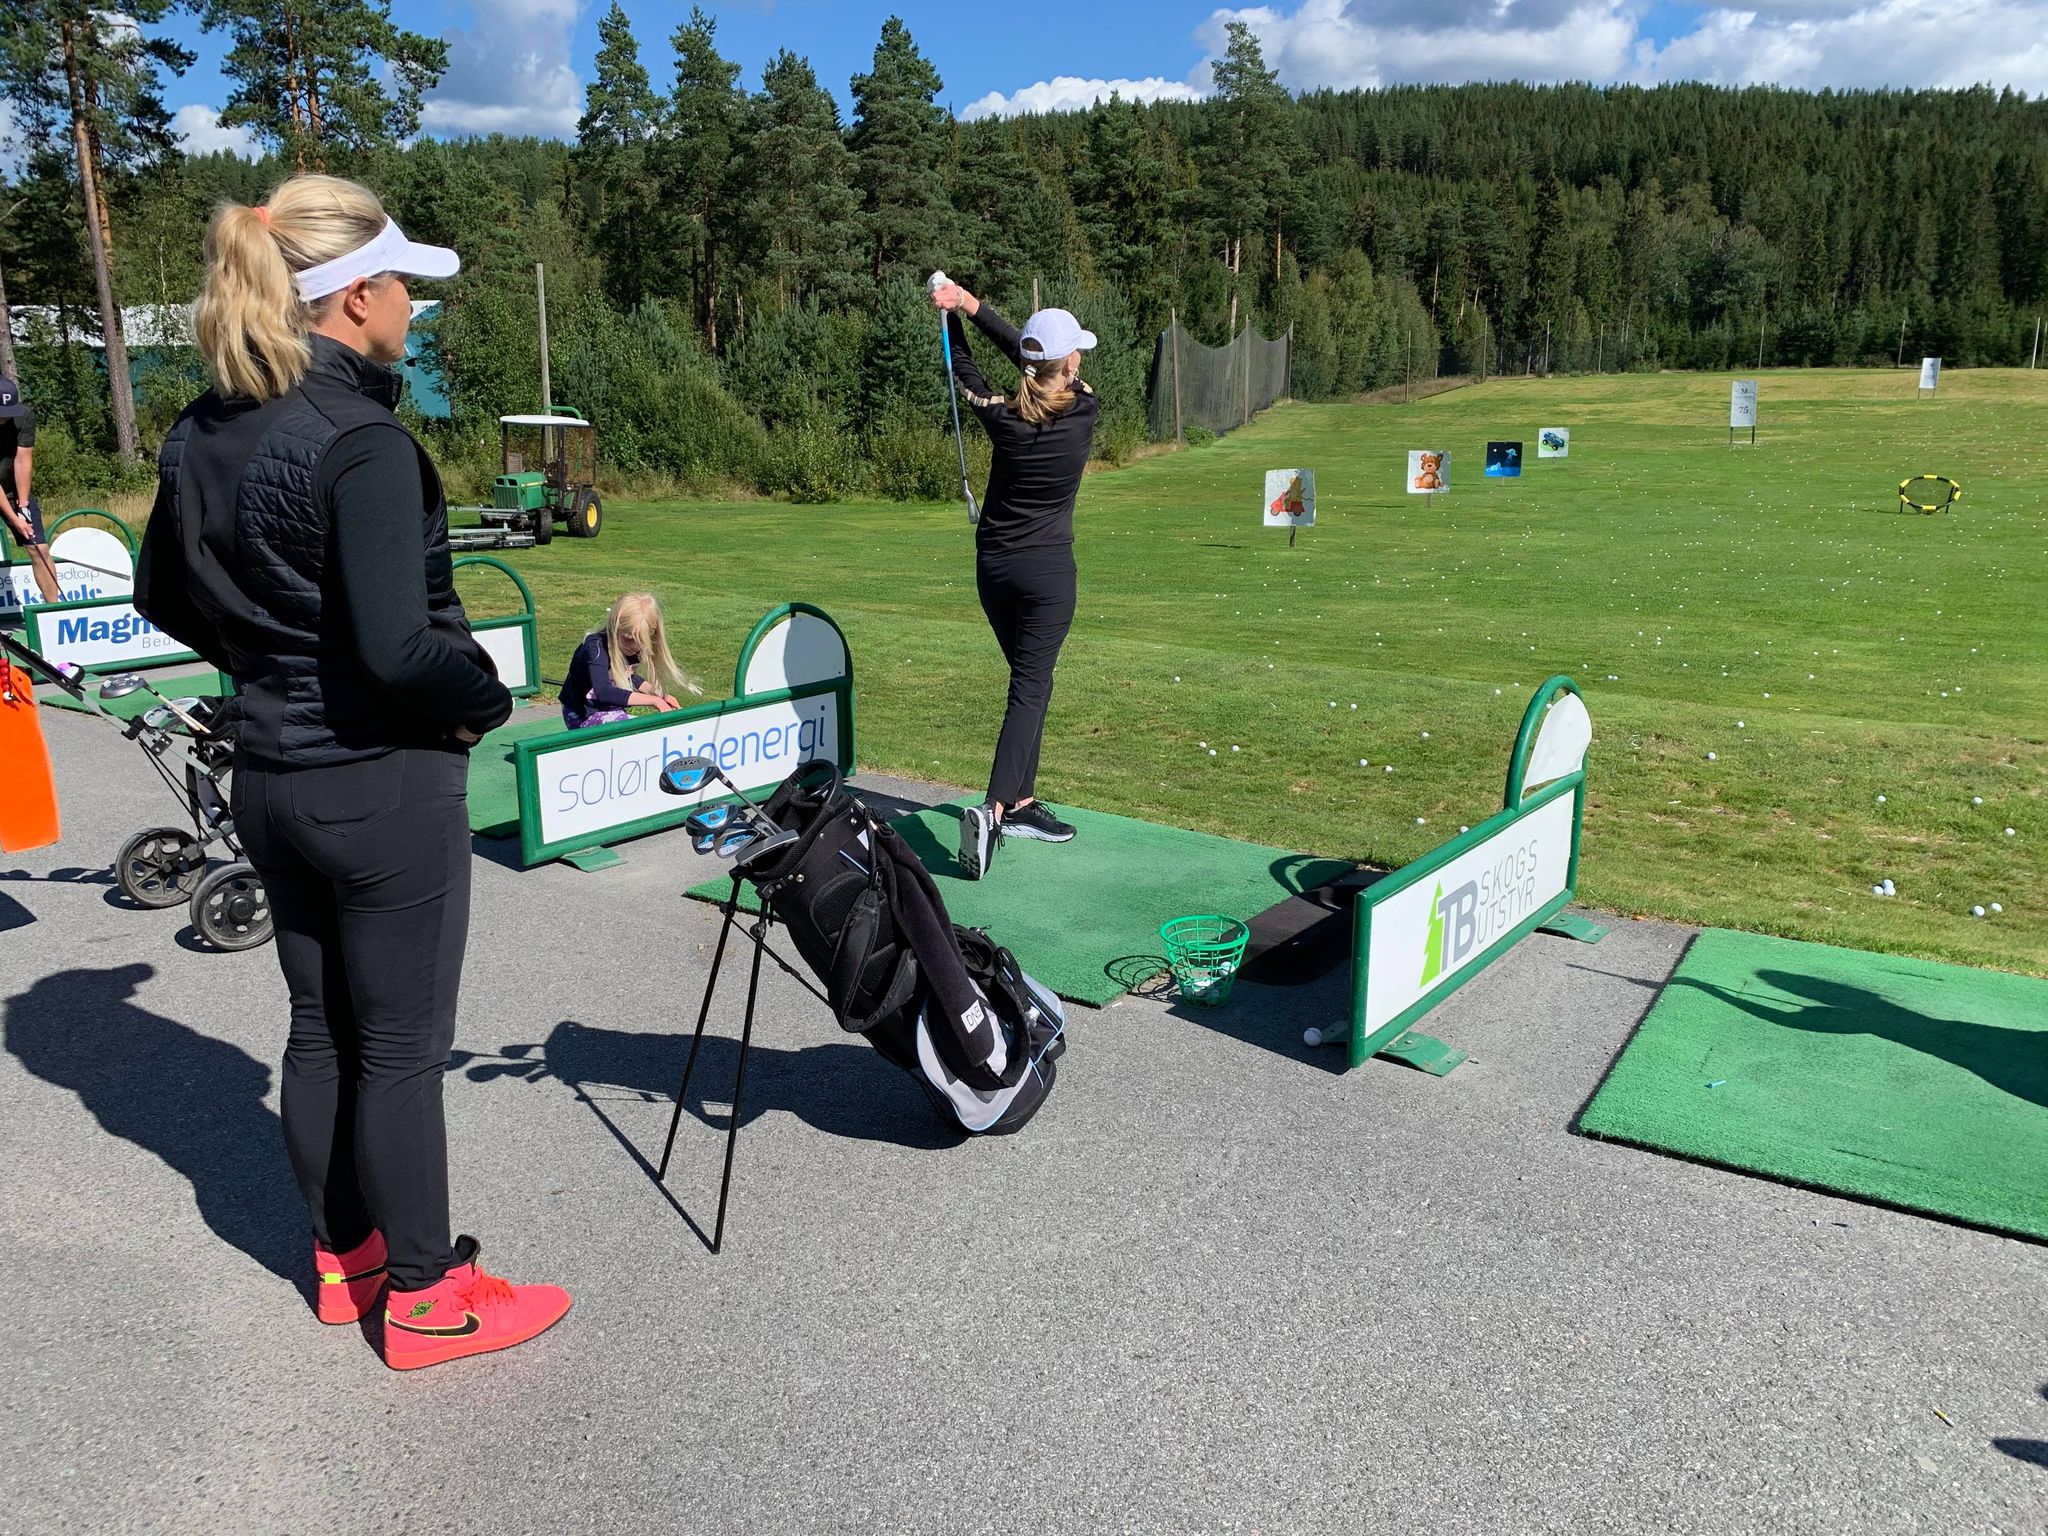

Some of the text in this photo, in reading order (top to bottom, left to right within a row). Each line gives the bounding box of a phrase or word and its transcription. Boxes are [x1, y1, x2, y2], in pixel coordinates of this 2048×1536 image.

[2, 393, 12, 405] P
[1738, 406, 1749, 414] 75
[23, 574, 31, 584] &
[56, 567, 100, 581] edtorp
[1480, 839, 1537, 906] SKOGS
[1477, 876, 1535, 944] UTSTYR
[1438, 879, 1478, 973] TB
[965, 1005, 982, 1027] DNB
